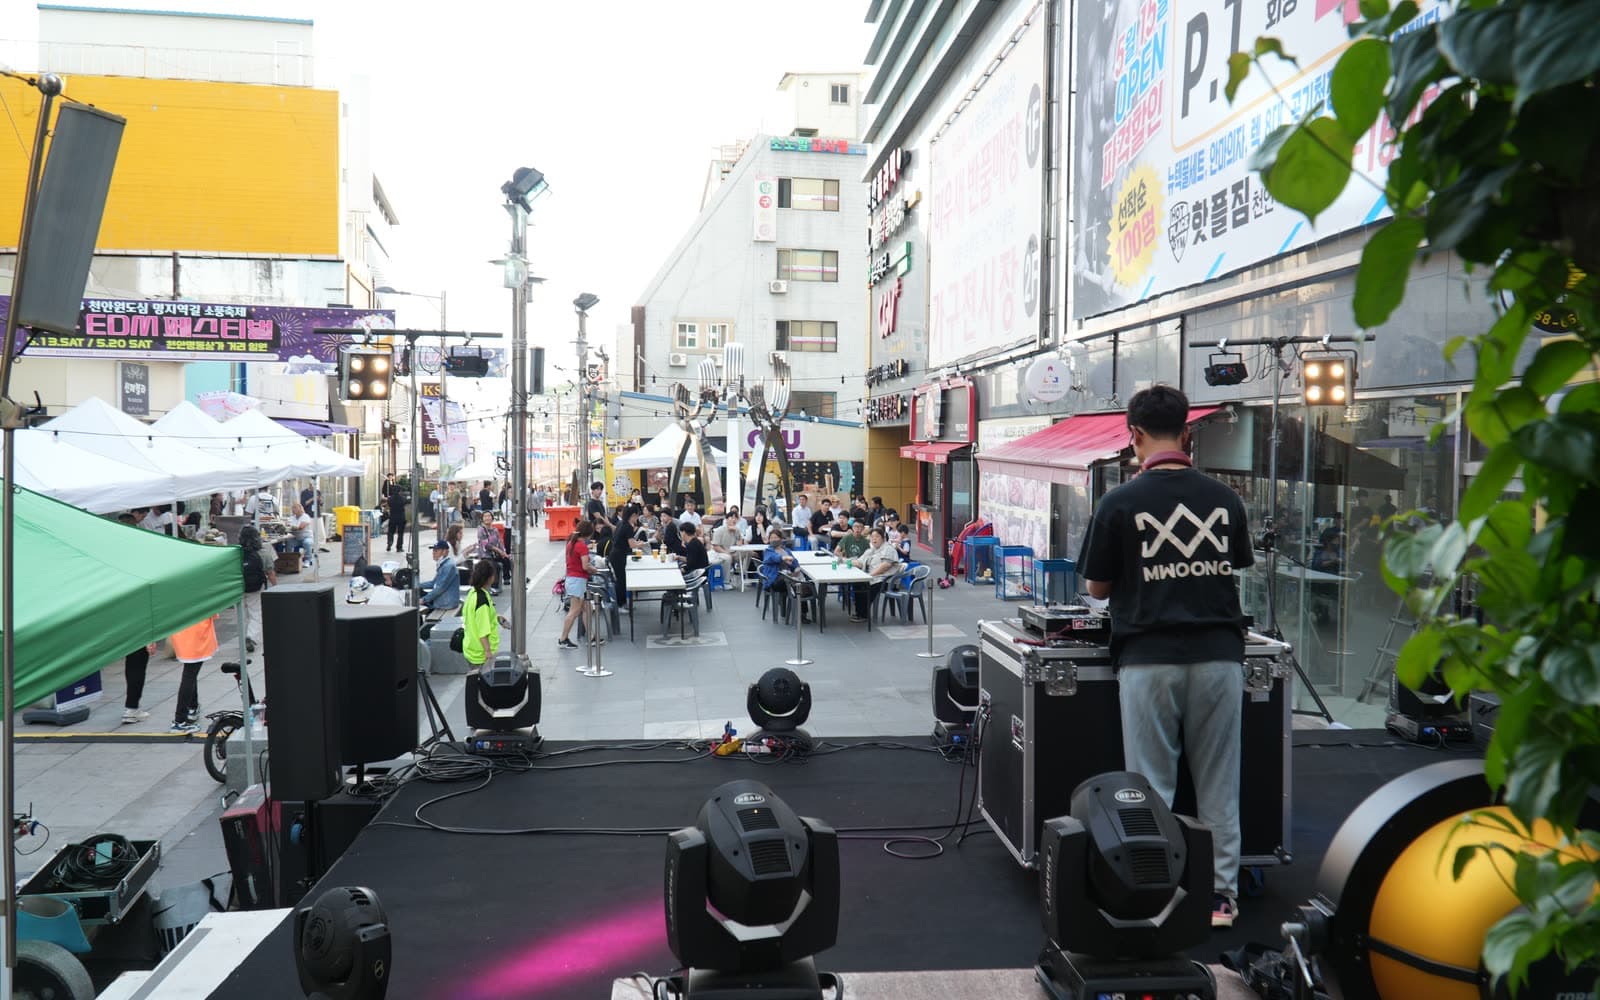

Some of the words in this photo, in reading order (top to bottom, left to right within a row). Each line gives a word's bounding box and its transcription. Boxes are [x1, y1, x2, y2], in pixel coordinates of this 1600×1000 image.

[1115, 22, 1137, 76] 5월
[1115, 22, 1167, 124] OPEN
[1103, 80, 1163, 185] 파격할인
[1118, 177, 1147, 232] 선착순
[1191, 176, 1250, 245] 핫플짐
[1116, 203, 1156, 273] 100명
[86, 313, 159, 337] EDM
[163, 316, 273, 340] 페스티벌
[88, 300, 148, 315] 천안원도심
[152, 303, 201, 317] 명지역길
[204, 306, 247, 318] 소풍축제
[96, 338, 126, 348] 5.20
[128, 339, 153, 349] SAT
[1143, 560, 1233, 582] MWOONG
